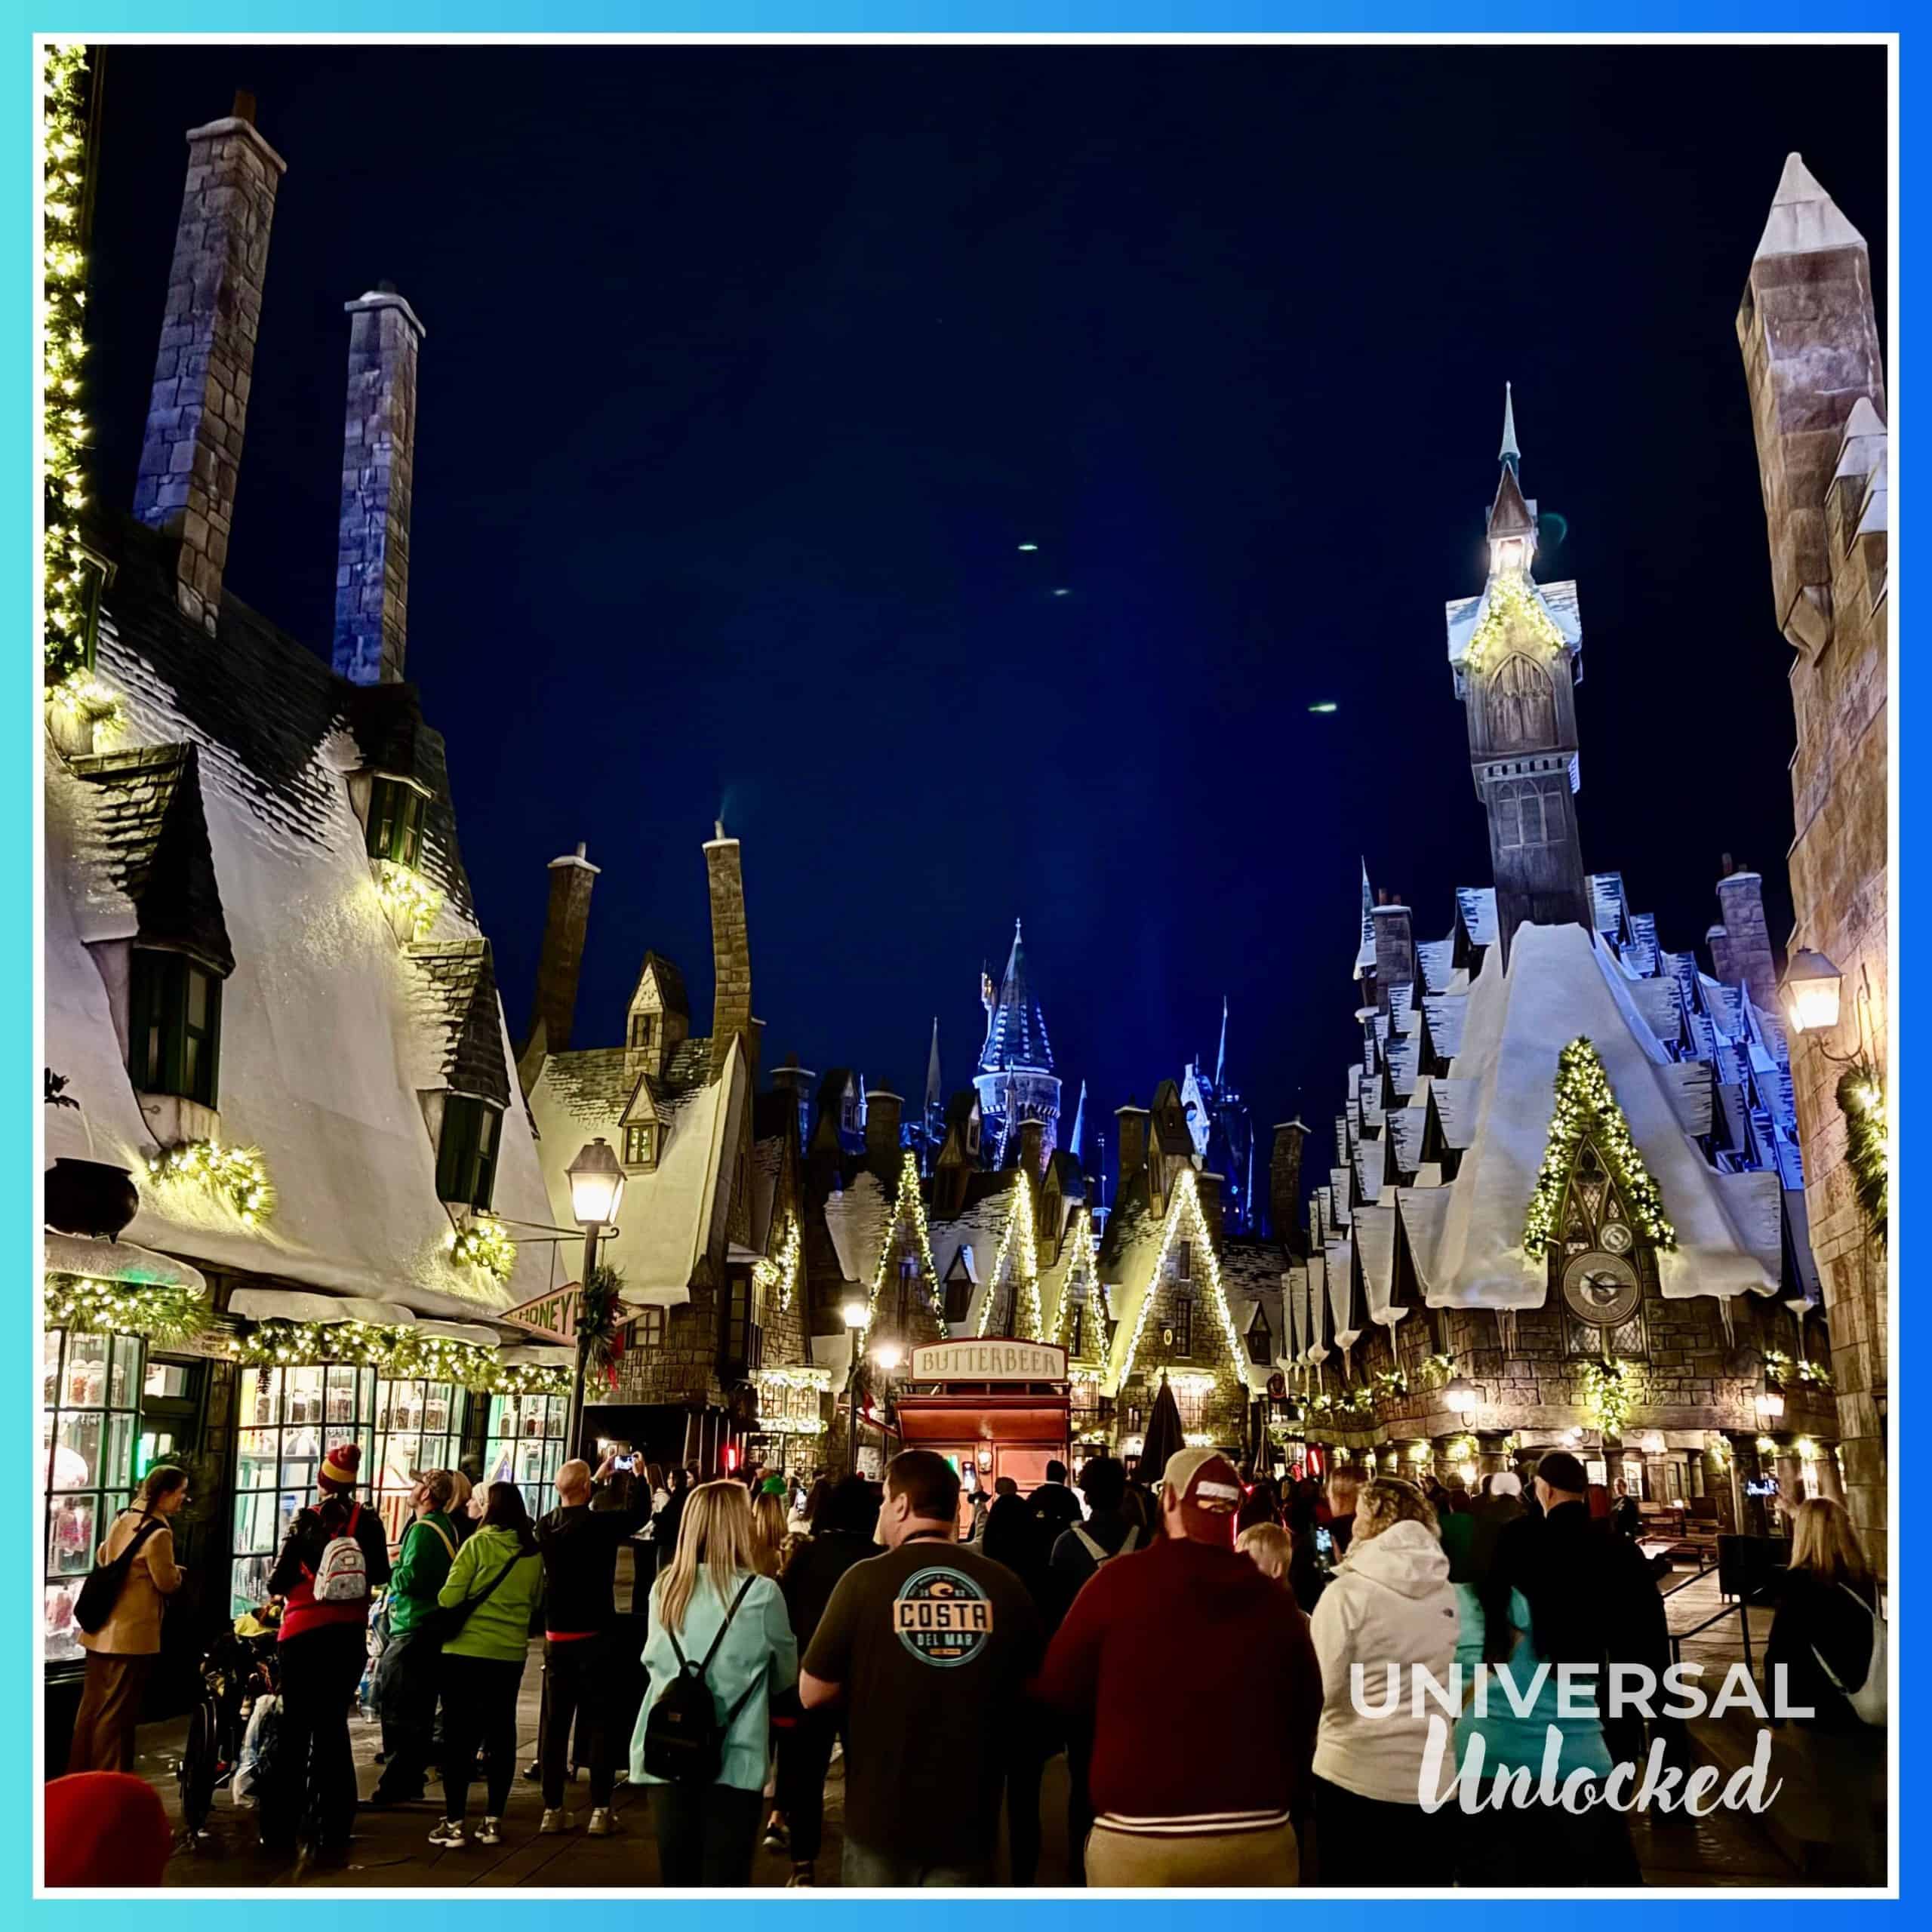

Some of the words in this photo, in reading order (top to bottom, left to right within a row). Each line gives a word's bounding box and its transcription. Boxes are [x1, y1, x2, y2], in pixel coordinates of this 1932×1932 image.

[922, 1346, 1057, 1375] BUTTERBEER
[900, 1603, 987, 1629] COSTA
[917, 1633, 938, 1646] DEL
[944, 1633, 973, 1646] MAR
